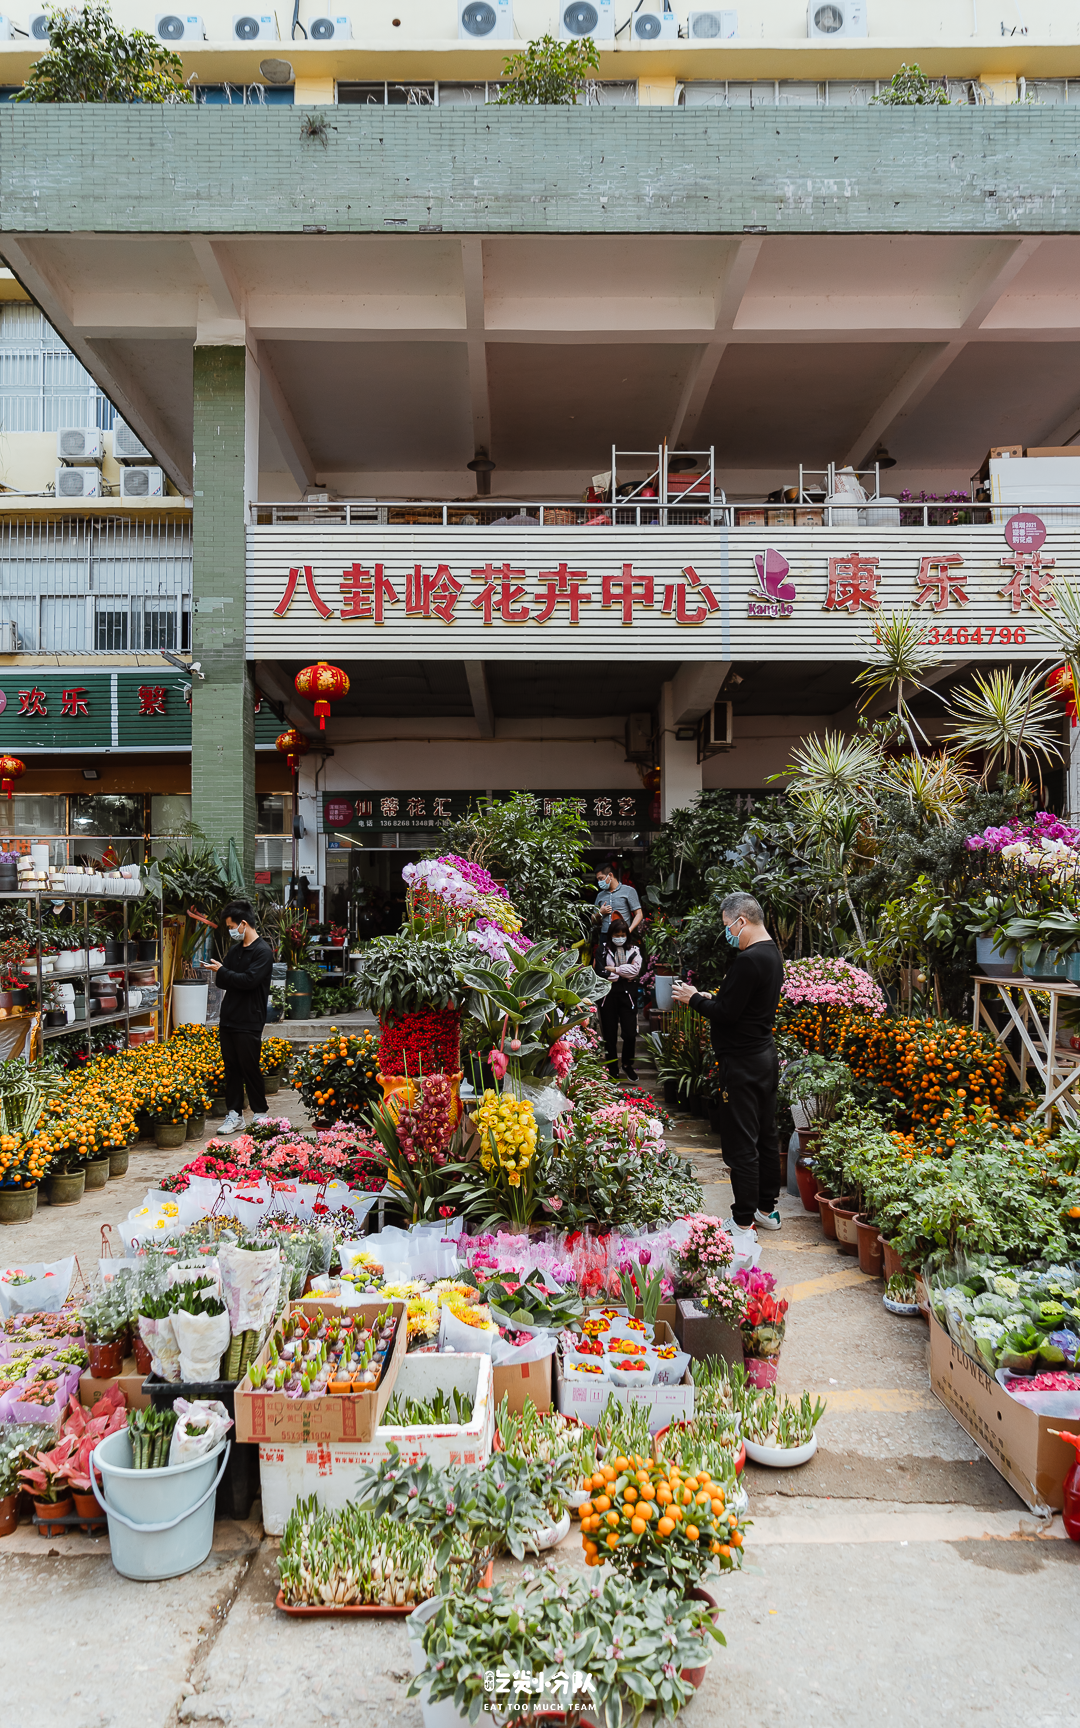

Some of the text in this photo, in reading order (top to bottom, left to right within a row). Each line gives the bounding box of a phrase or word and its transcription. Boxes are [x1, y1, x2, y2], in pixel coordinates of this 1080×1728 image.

[273, 562, 721, 625] 八卦岭花卉中心
[822, 551, 1057, 613] 康乐花
[748, 602, 779, 618] Kang
[16, 686, 89, 716] 欢乐
[951, 1341, 993, 1396] FLOWER
